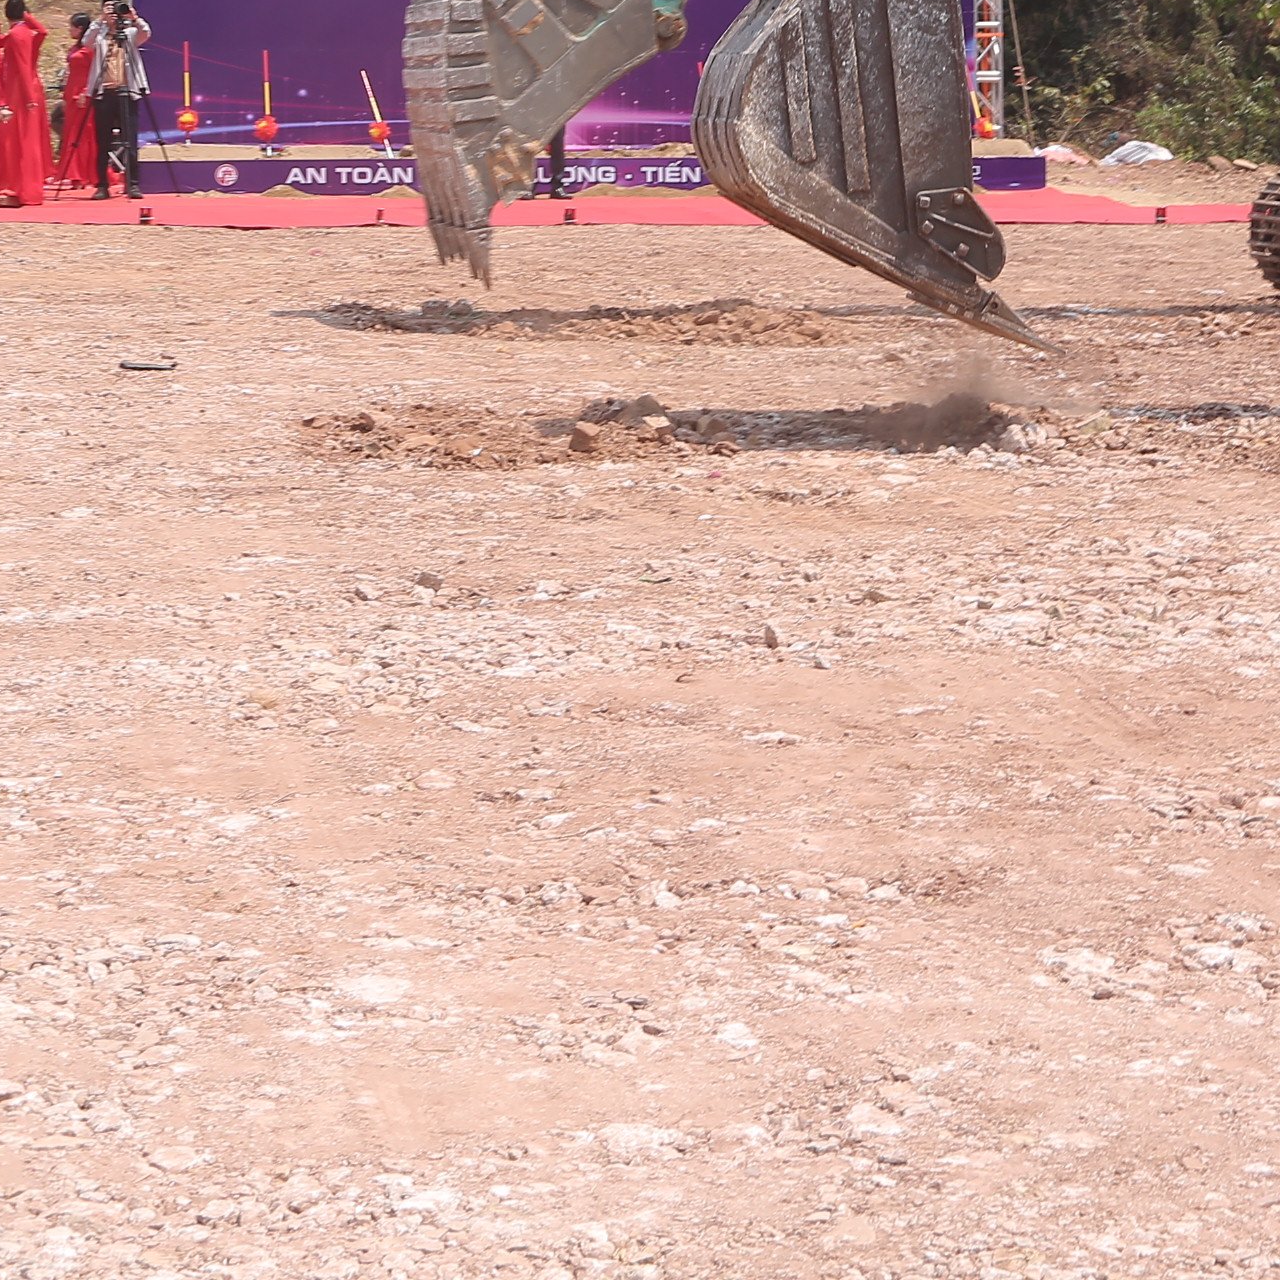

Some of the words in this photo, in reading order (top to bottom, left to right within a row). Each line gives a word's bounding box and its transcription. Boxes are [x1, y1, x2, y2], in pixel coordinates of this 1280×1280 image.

[285, 167, 328, 184] AN
[335, 162, 414, 184] TOÀN
[640, 161, 702, 183] TIẾN
